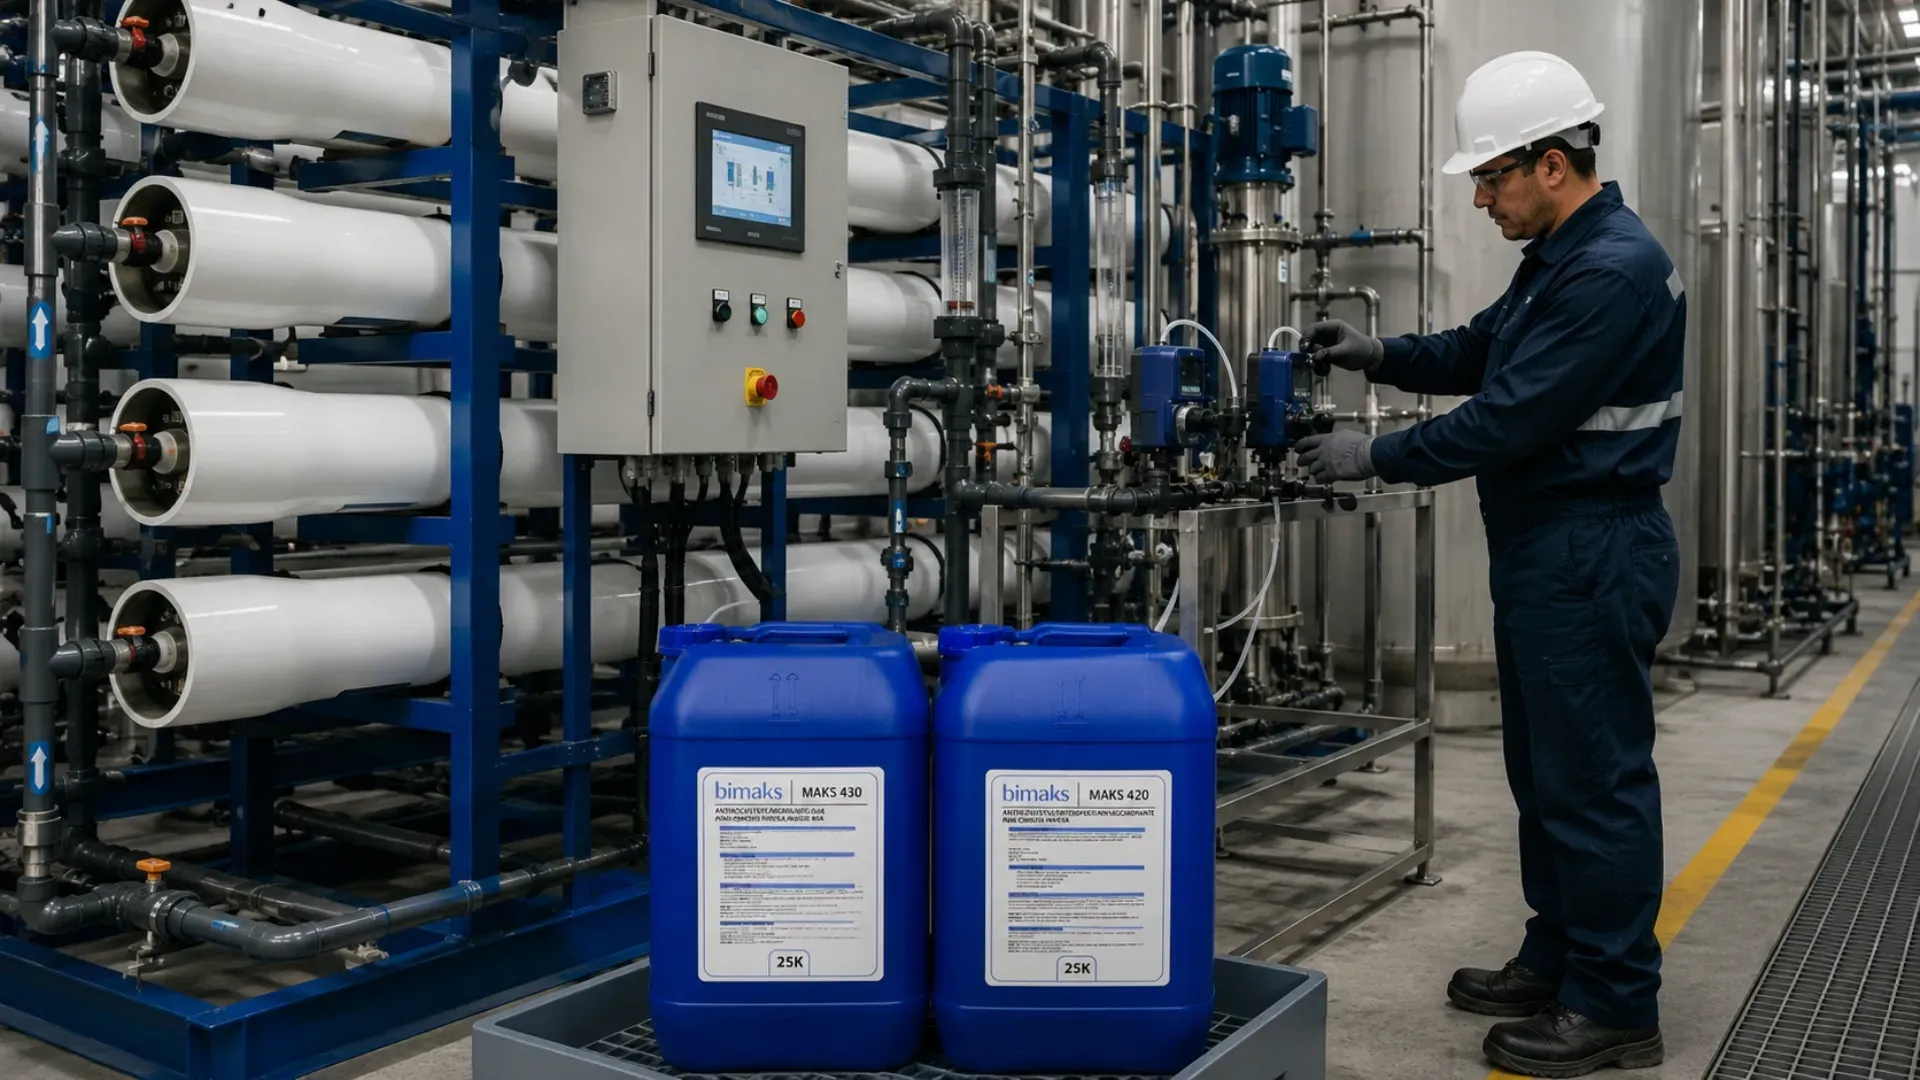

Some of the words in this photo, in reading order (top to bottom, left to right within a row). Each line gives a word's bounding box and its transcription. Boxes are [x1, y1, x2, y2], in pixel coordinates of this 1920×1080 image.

[715, 780, 783, 800] bimaks
[802, 786, 837, 798] MAKS
[840, 786, 863, 798] 430
[1002, 783, 1070, 802] bimaks
[1089, 789, 1124, 800] MAKS
[1127, 789, 1150, 800] 420
[776, 955, 804, 968] 25K
[1064, 962, 1091, 974] 25K
